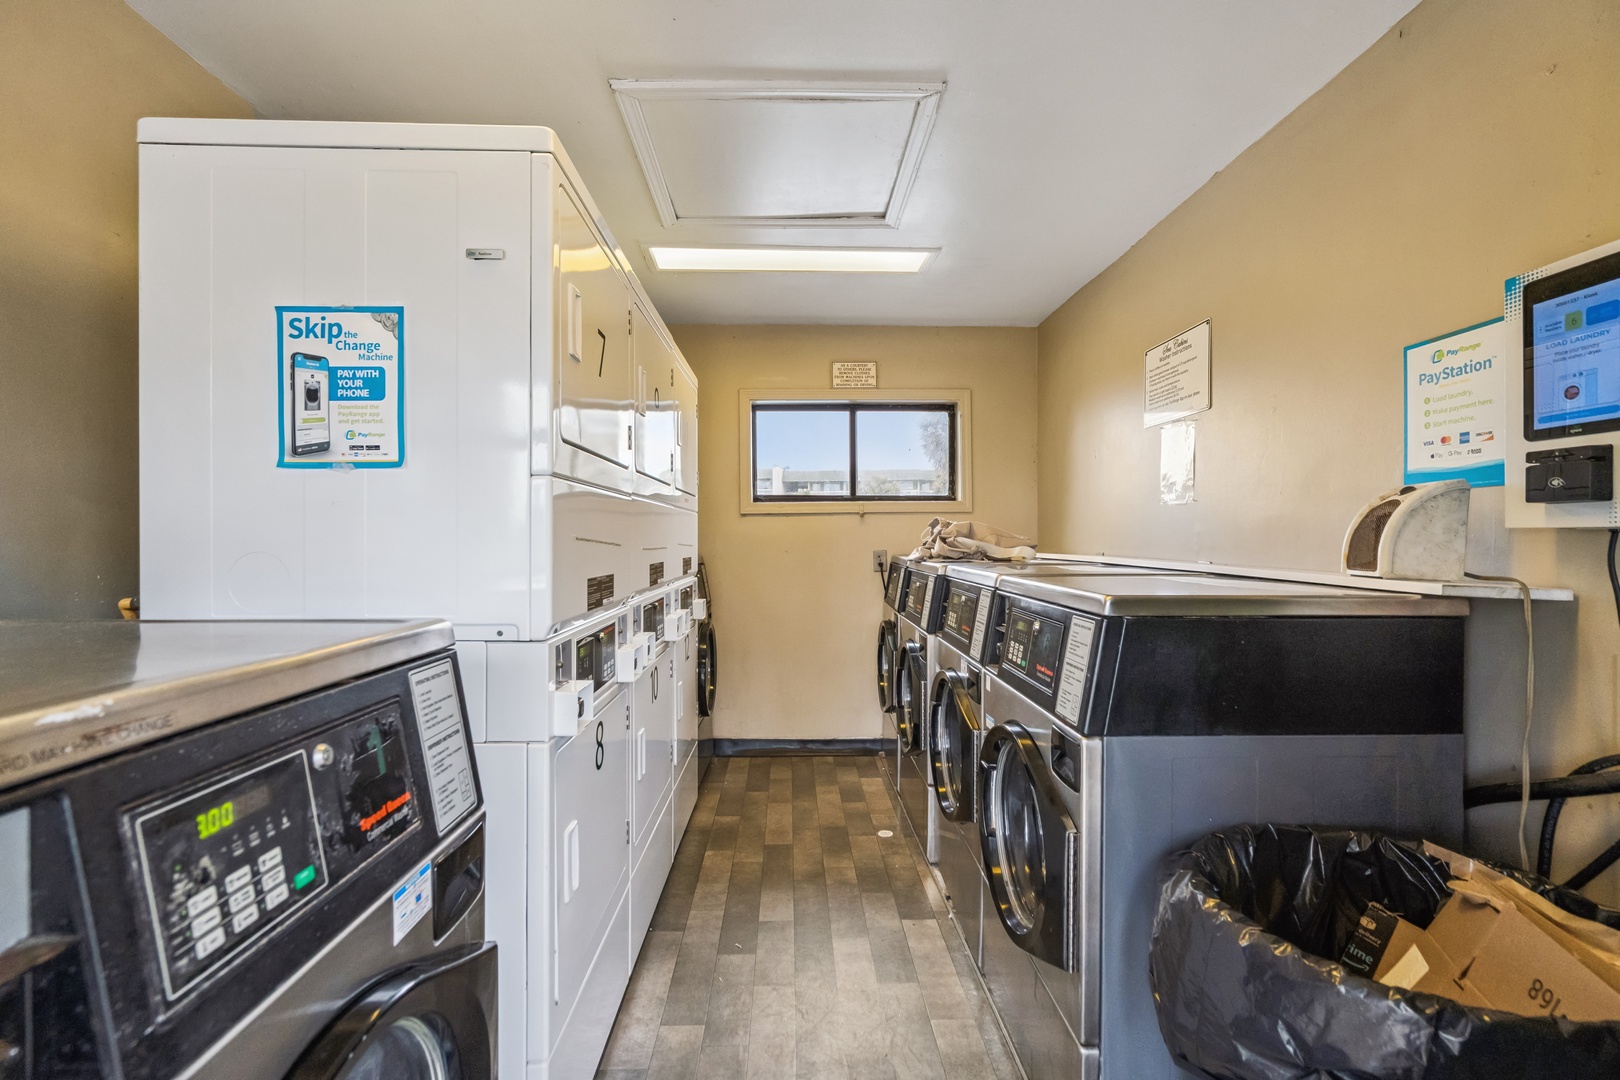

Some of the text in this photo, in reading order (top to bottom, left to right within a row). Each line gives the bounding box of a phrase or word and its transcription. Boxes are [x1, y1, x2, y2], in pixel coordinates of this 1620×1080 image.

[1571, 317, 1577, 325] 6
[288, 316, 358, 344] Skip the
[1546, 329, 1611, 349] LOAD LAUNDRY
[336, 340, 380, 353] Change
[597, 328, 606, 377] 7
[1159, 344, 1192, 362] Washer Instructions
[1446, 342, 1481, 357] PayRange
[358, 353, 393, 361] Machine
[338, 370, 379, 378] PAY WITH
[338, 379, 363, 387] YOUR
[338, 389, 369, 397] PHONE
[1433, 394, 1447, 402] Load
[1448, 389, 1474, 400] laundry.
[1433, 406, 1448, 415] Make
[1449, 401, 1477, 413] payment
[1478, 398, 1495, 406] here.
[1433, 420, 1447, 428] Start
[1448, 415, 1476, 425] machine.
[650, 666, 659, 704] 10
[595, 721, 604, 770] 8
